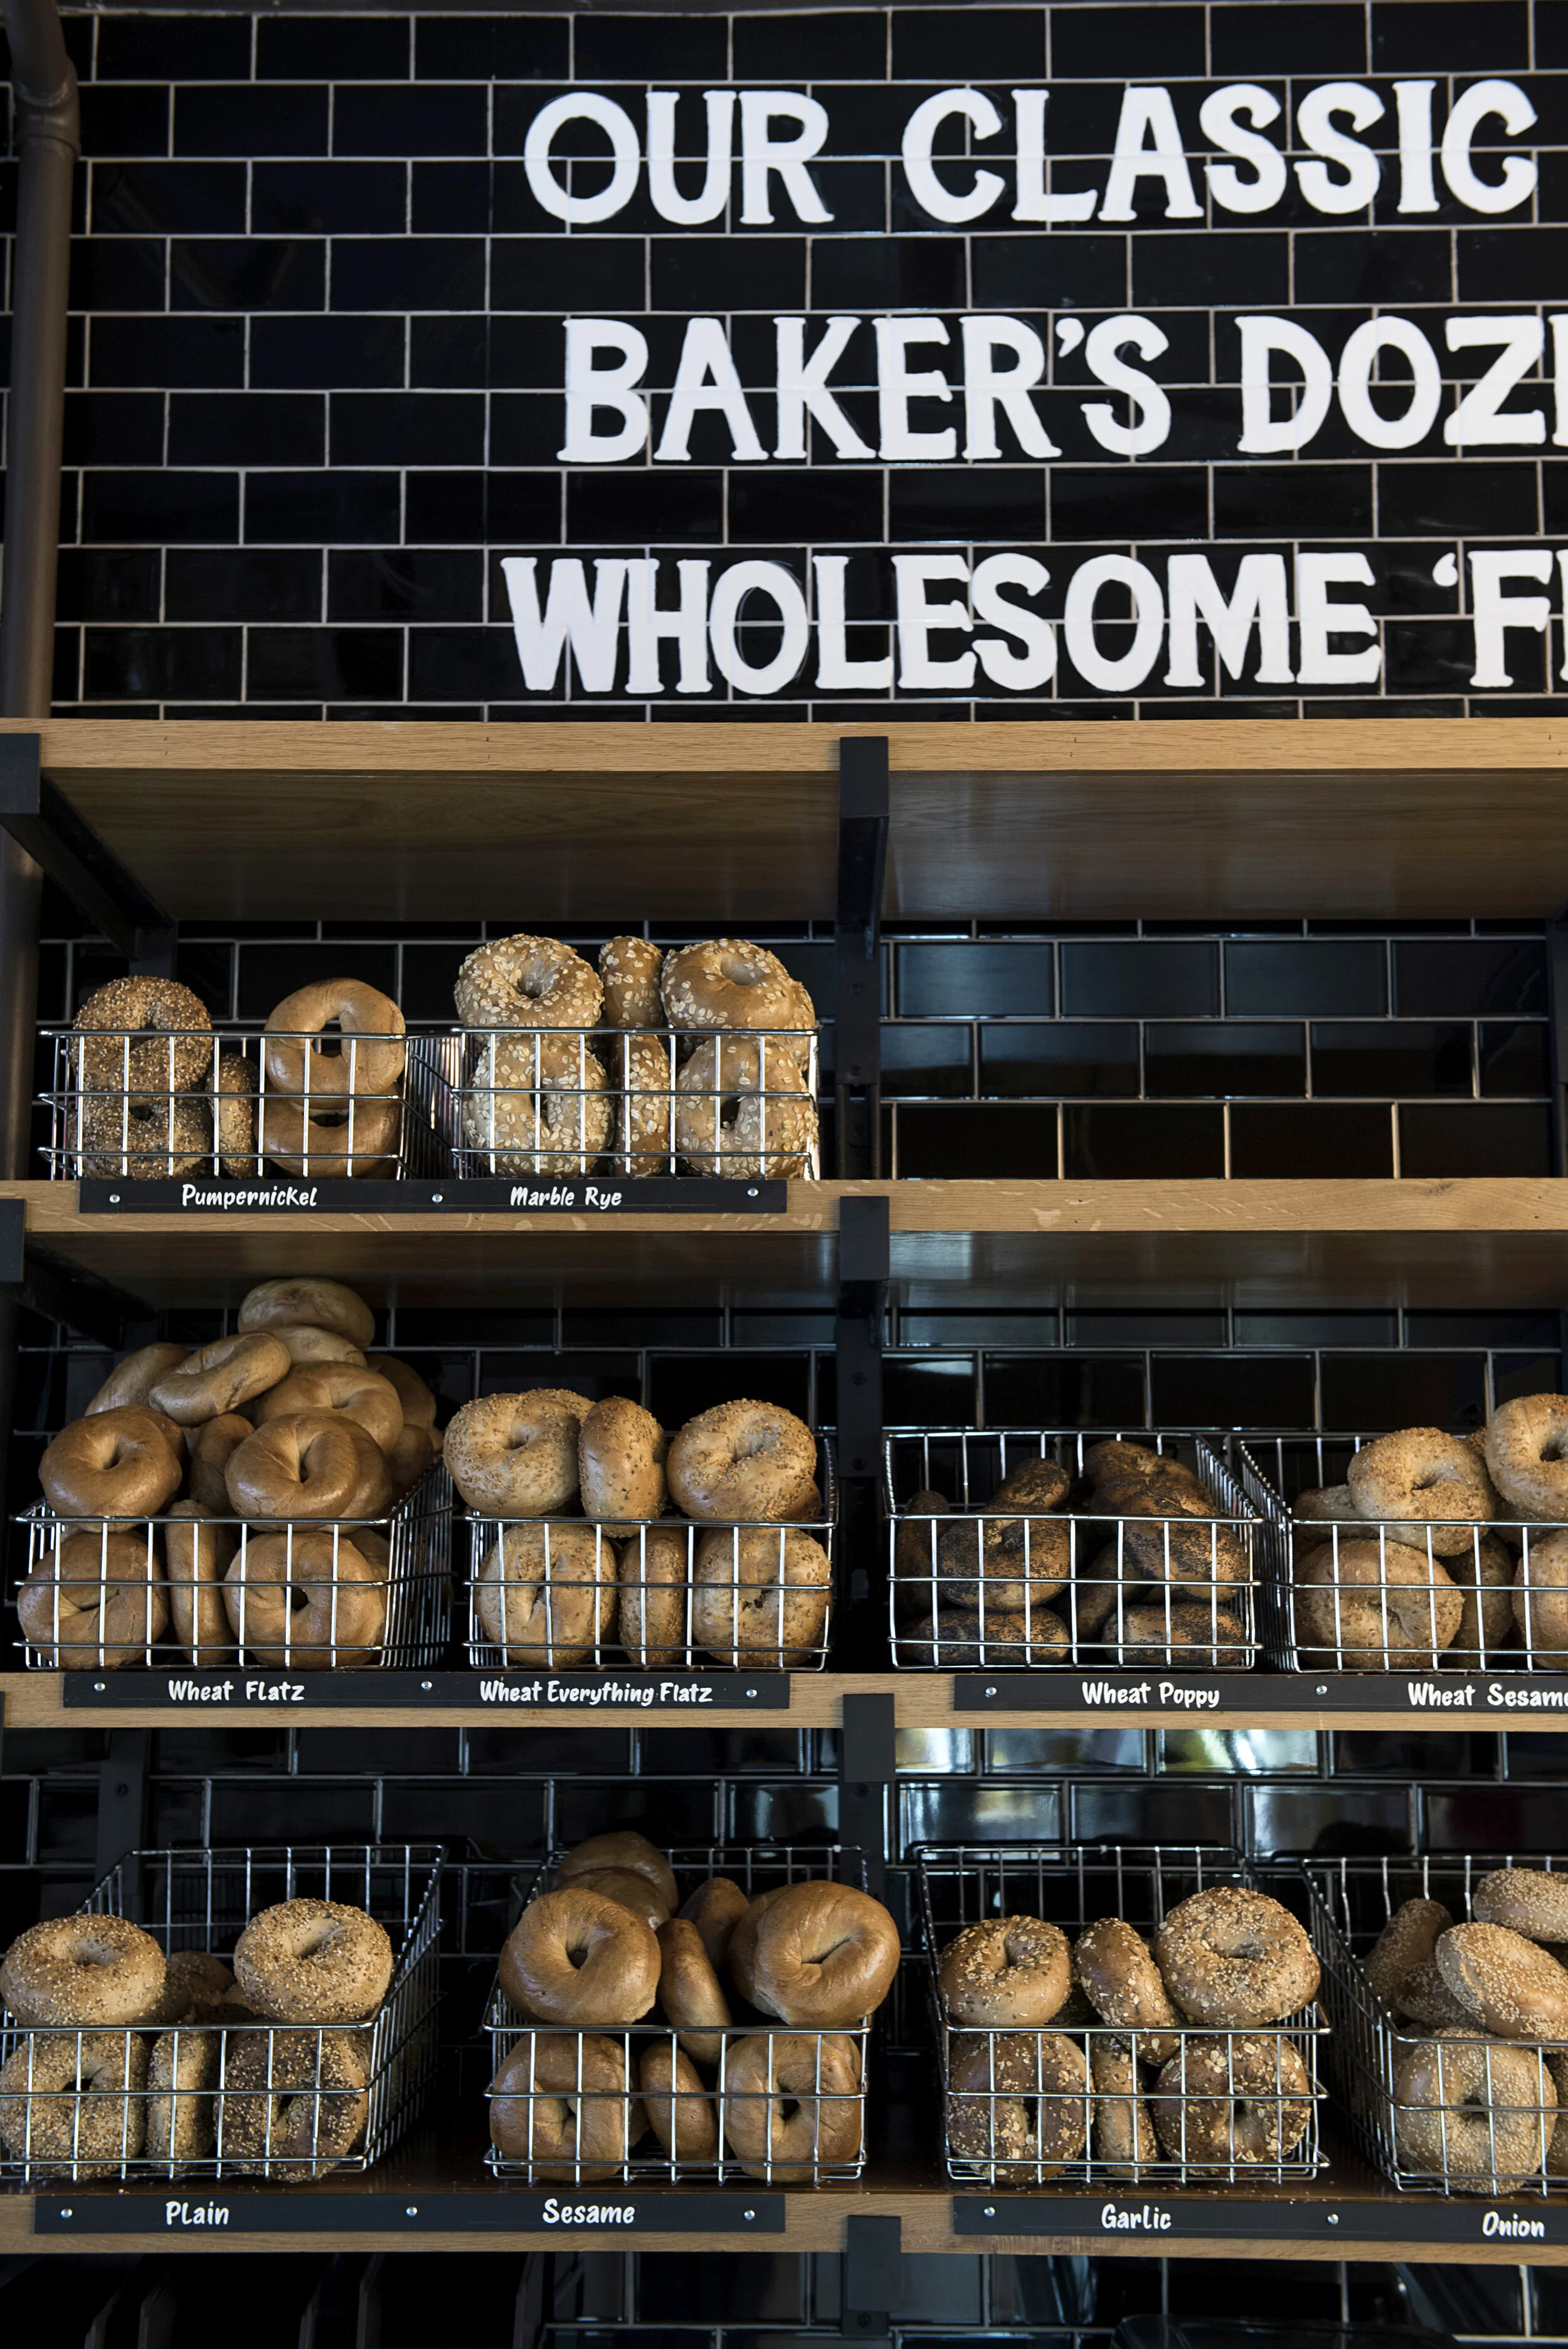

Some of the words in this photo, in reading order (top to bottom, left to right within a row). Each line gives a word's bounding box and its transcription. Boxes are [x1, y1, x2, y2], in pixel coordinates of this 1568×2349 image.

[526, 90, 835, 225] OUR
[902, 80, 1539, 223] CLASSIC
[556, 314, 1172, 463] BAKER’S
[1236, 314, 1568, 453] DOZ
[501, 552, 1382, 695] WHOLESOME
[182, 1184, 317, 1210] Pumpernickel
[510, 1185, 576, 1207] Marble
[585, 1185, 623, 1211] Rye
[168, 1679, 235, 1702] Wheat
[246, 1680, 305, 1702] Flatz
[479, 1680, 543, 1702] Wheat
[547, 1680, 655, 1707] Everything
[659, 1681, 714, 1703] Flatz
[1081, 1681, 1152, 1705] Wheat
[1158, 1681, 1221, 1709] Poppy
[1407, 1682, 1476, 1707] Wheat
[166, 2200, 230, 2225] Plain
[542, 2198, 636, 2225] Sesame
[1101, 2203, 1172, 2230] Garlic
[1481, 2210, 1545, 2237] Onion
